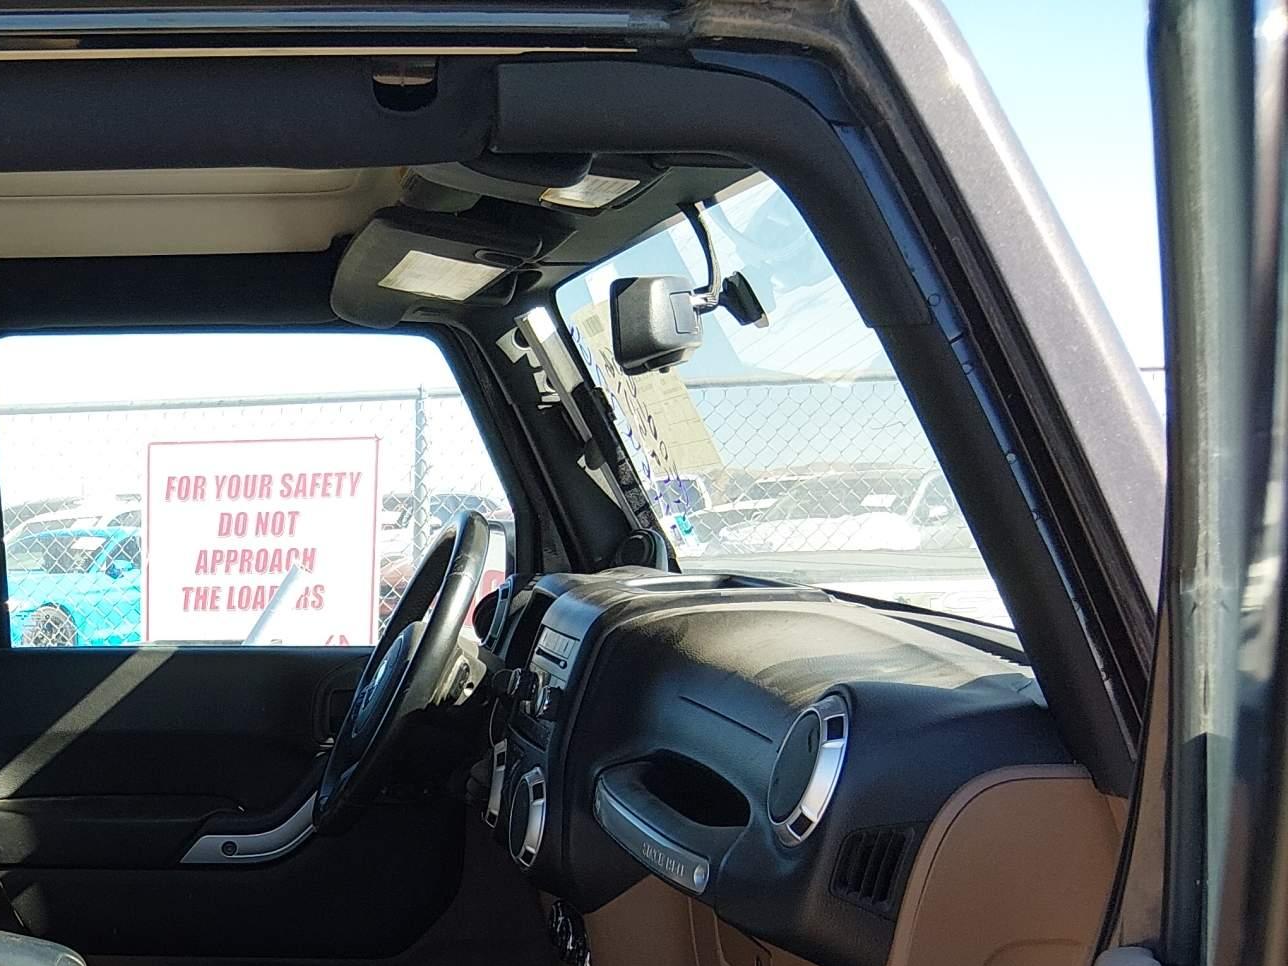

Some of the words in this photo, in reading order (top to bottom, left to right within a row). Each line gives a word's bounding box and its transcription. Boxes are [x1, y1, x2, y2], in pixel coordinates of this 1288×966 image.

[165, 475, 207, 501] FOR
[215, 474, 272, 500] YOUR
[279, 471, 362, 499] SAFETY
[218, 511, 248, 538] DO
[255, 510, 300, 537] NOT
[195, 547, 317, 575] APPROACH
[182, 585, 221, 612] THE
